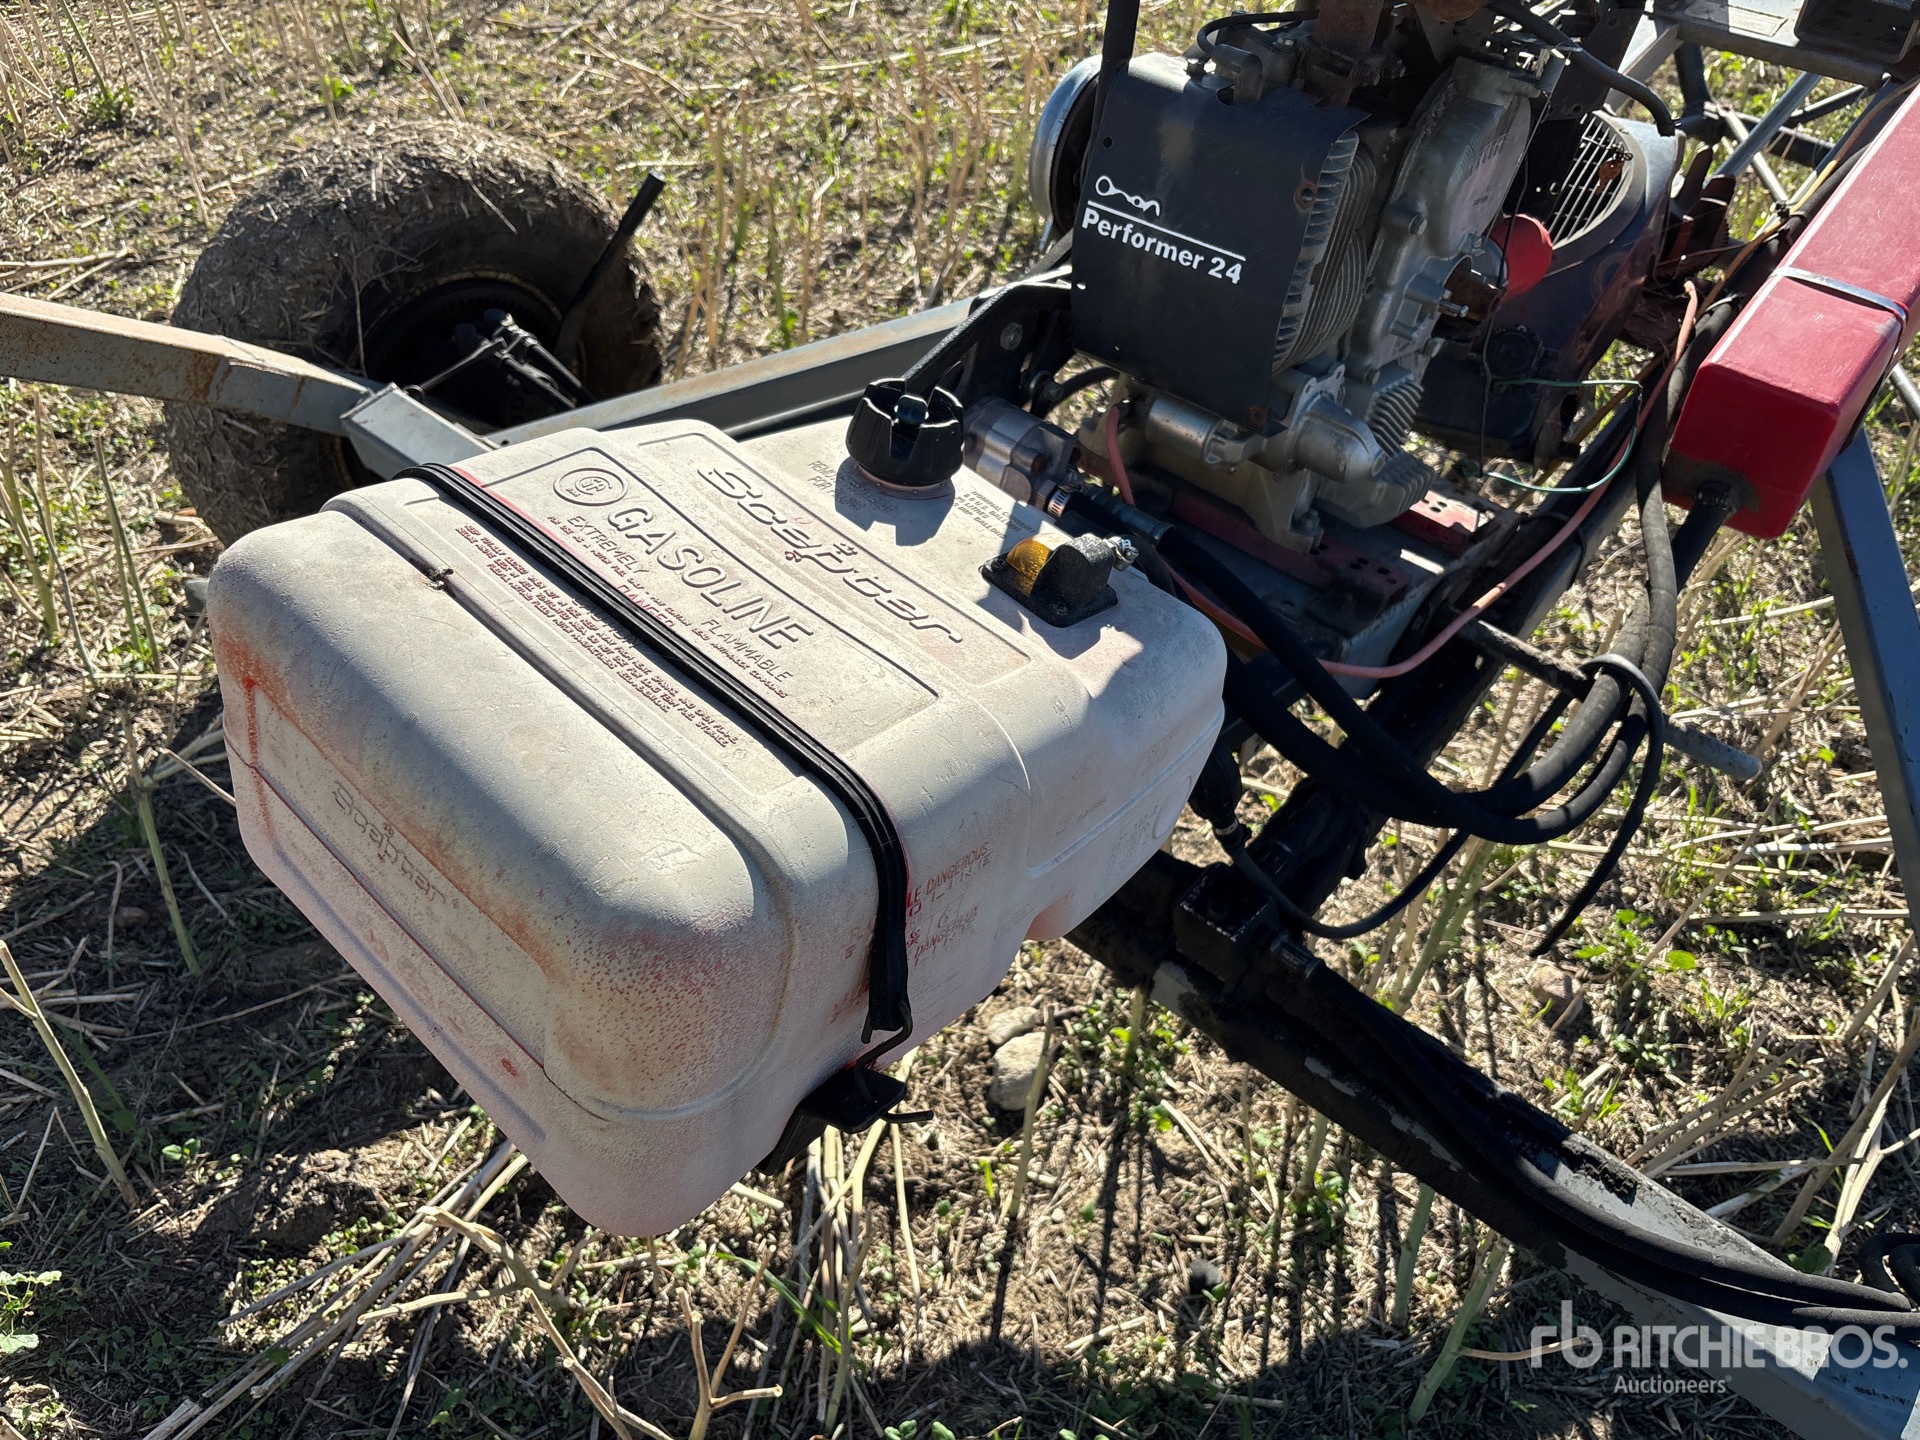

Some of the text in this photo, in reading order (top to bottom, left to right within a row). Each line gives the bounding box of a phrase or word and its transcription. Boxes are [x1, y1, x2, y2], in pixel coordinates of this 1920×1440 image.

[1081, 207, 1243, 285] Performer 24
[567, 515, 793, 683] EXTREMELY FLAMMABLE
[607, 507, 814, 650] GASOLINE
[926, 841, 990, 896] DANGEROUS
